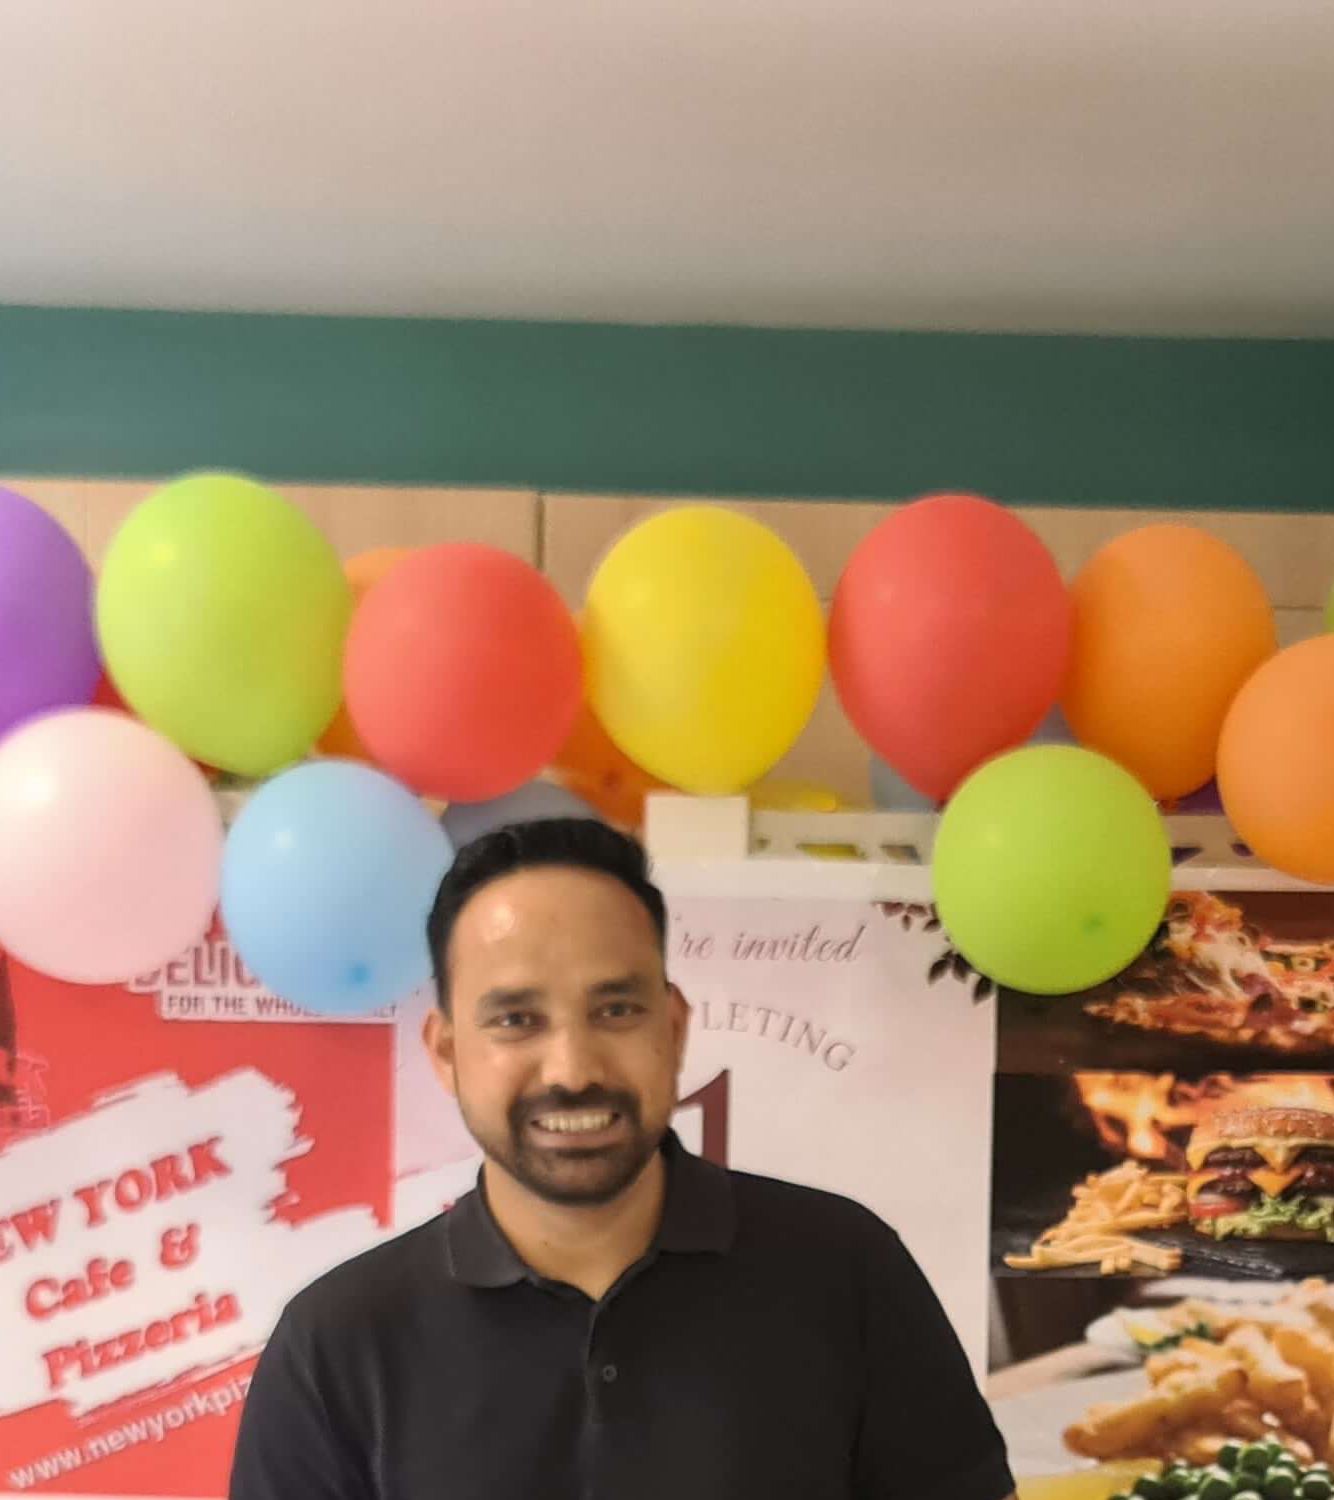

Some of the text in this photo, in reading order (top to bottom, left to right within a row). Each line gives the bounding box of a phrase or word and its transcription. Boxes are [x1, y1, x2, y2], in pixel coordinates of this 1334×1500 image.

[733, 923, 867, 963] invited
[168, 995, 206, 1016] FOR
[212, 996, 247, 1016] THE
[72, 1136, 234, 1228] YORK
[24, 1222, 200, 1322] Cafe &
[41, 1292, 243, 1392] Pizzeria
